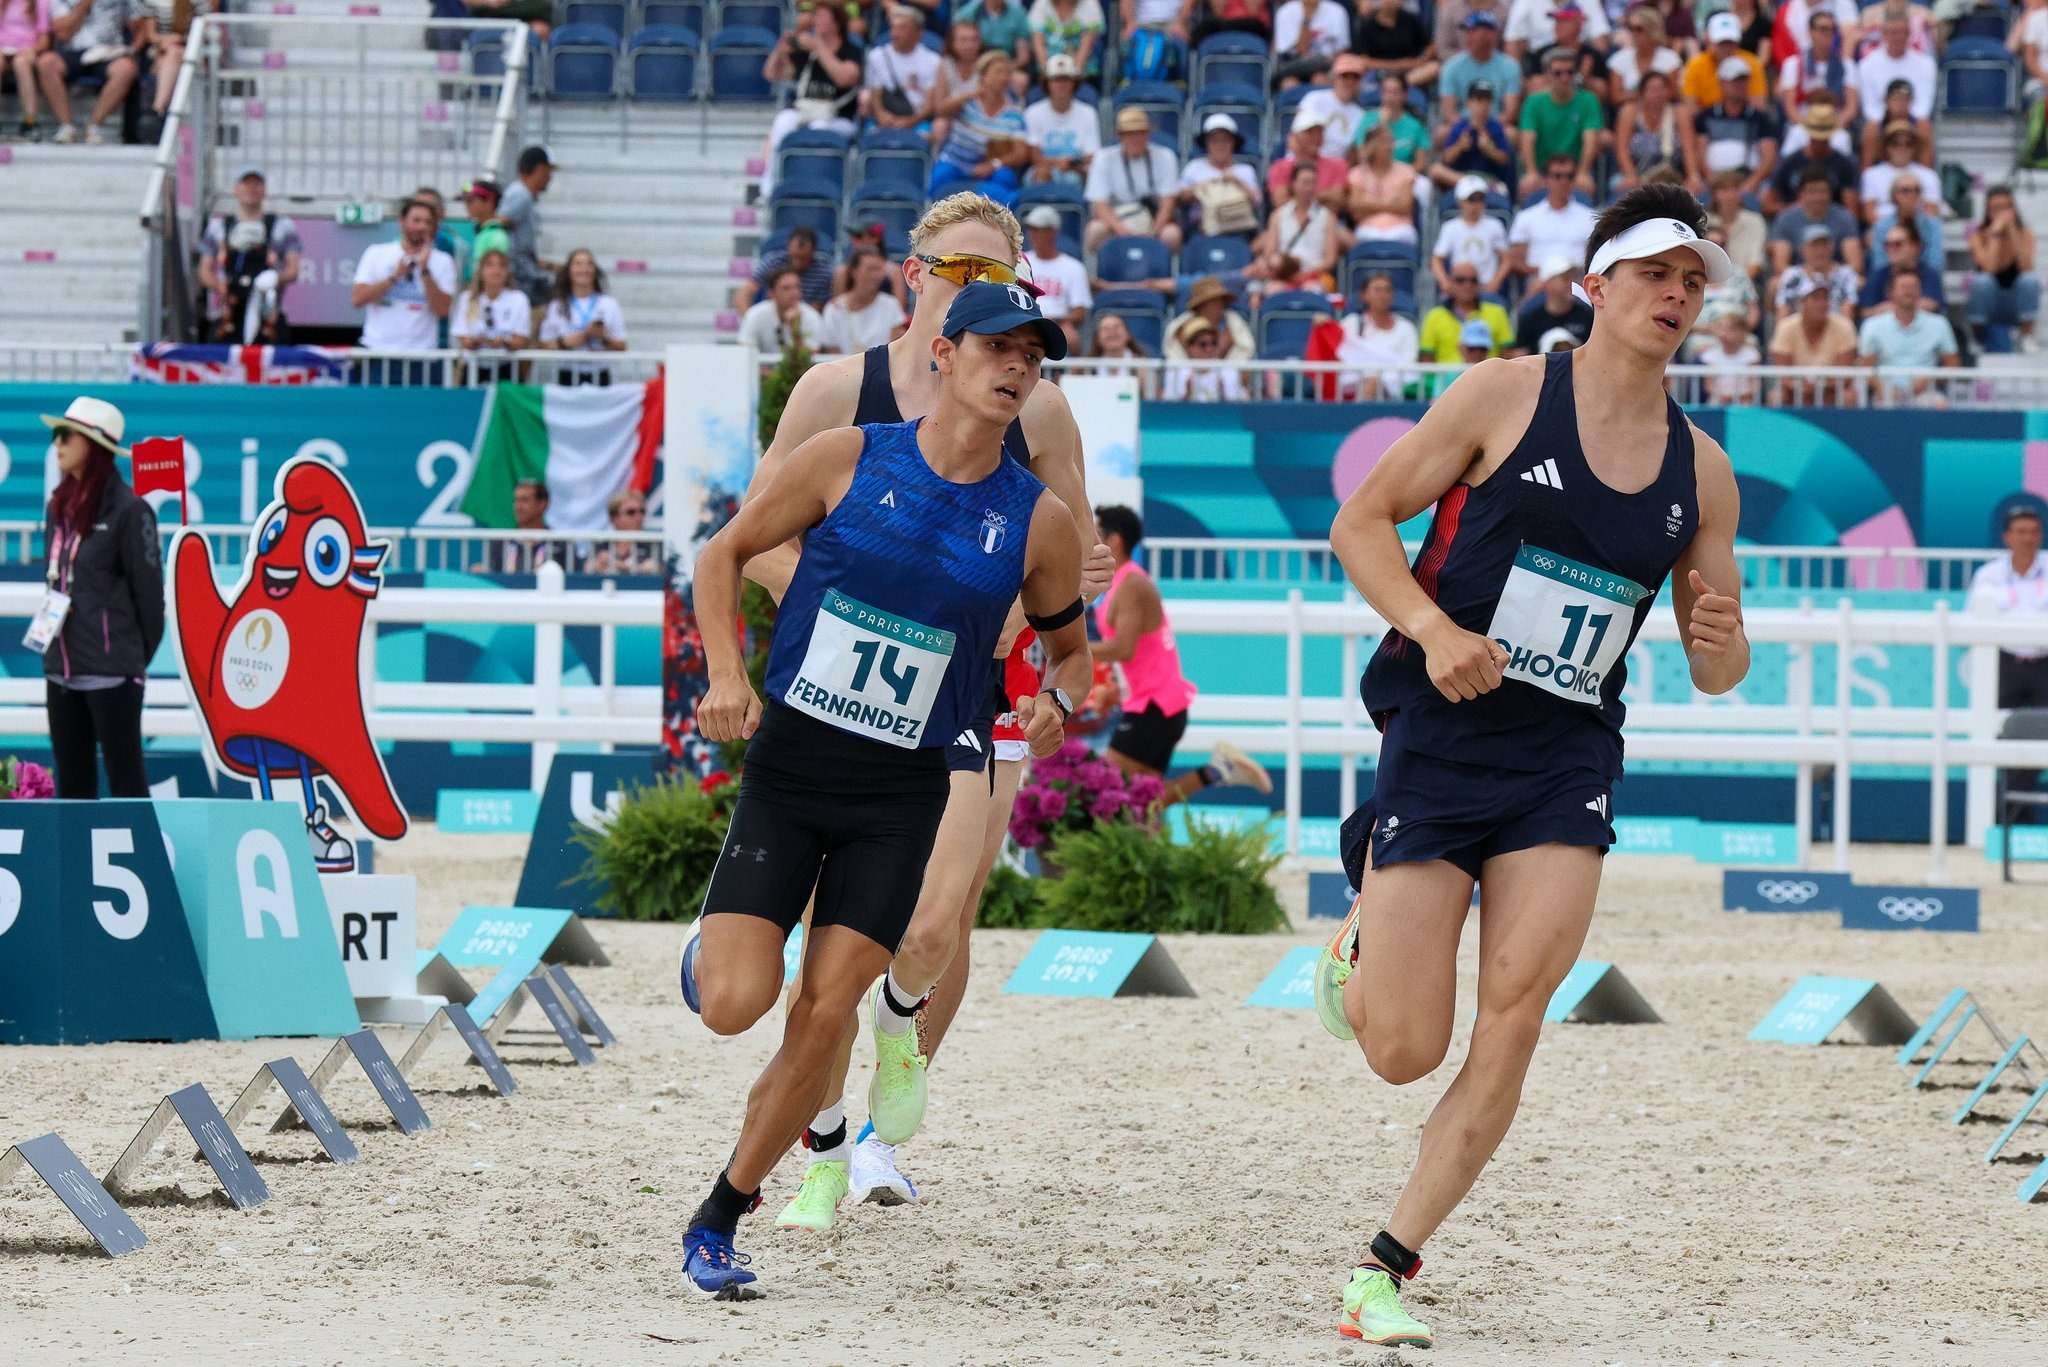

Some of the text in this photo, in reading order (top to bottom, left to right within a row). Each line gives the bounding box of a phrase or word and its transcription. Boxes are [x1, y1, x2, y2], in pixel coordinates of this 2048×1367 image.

[298, 257, 355, 286] RIS
[1560, 565, 1633, 598] PARIS 2024
[858, 610, 943, 647] PARIS 2024
[1557, 604, 1613, 667] 11
[849, 640, 920, 706] 14
[792, 676, 921, 740] FERNANDEZ
[91, 827, 149, 940] 5
[236, 829, 299, 938] A
[475, 920, 533, 938] PARIS
[462, 937, 519, 956] 2024
[1054, 944, 1113, 965] PARIS
[1041, 964, 1099, 983] 2024
